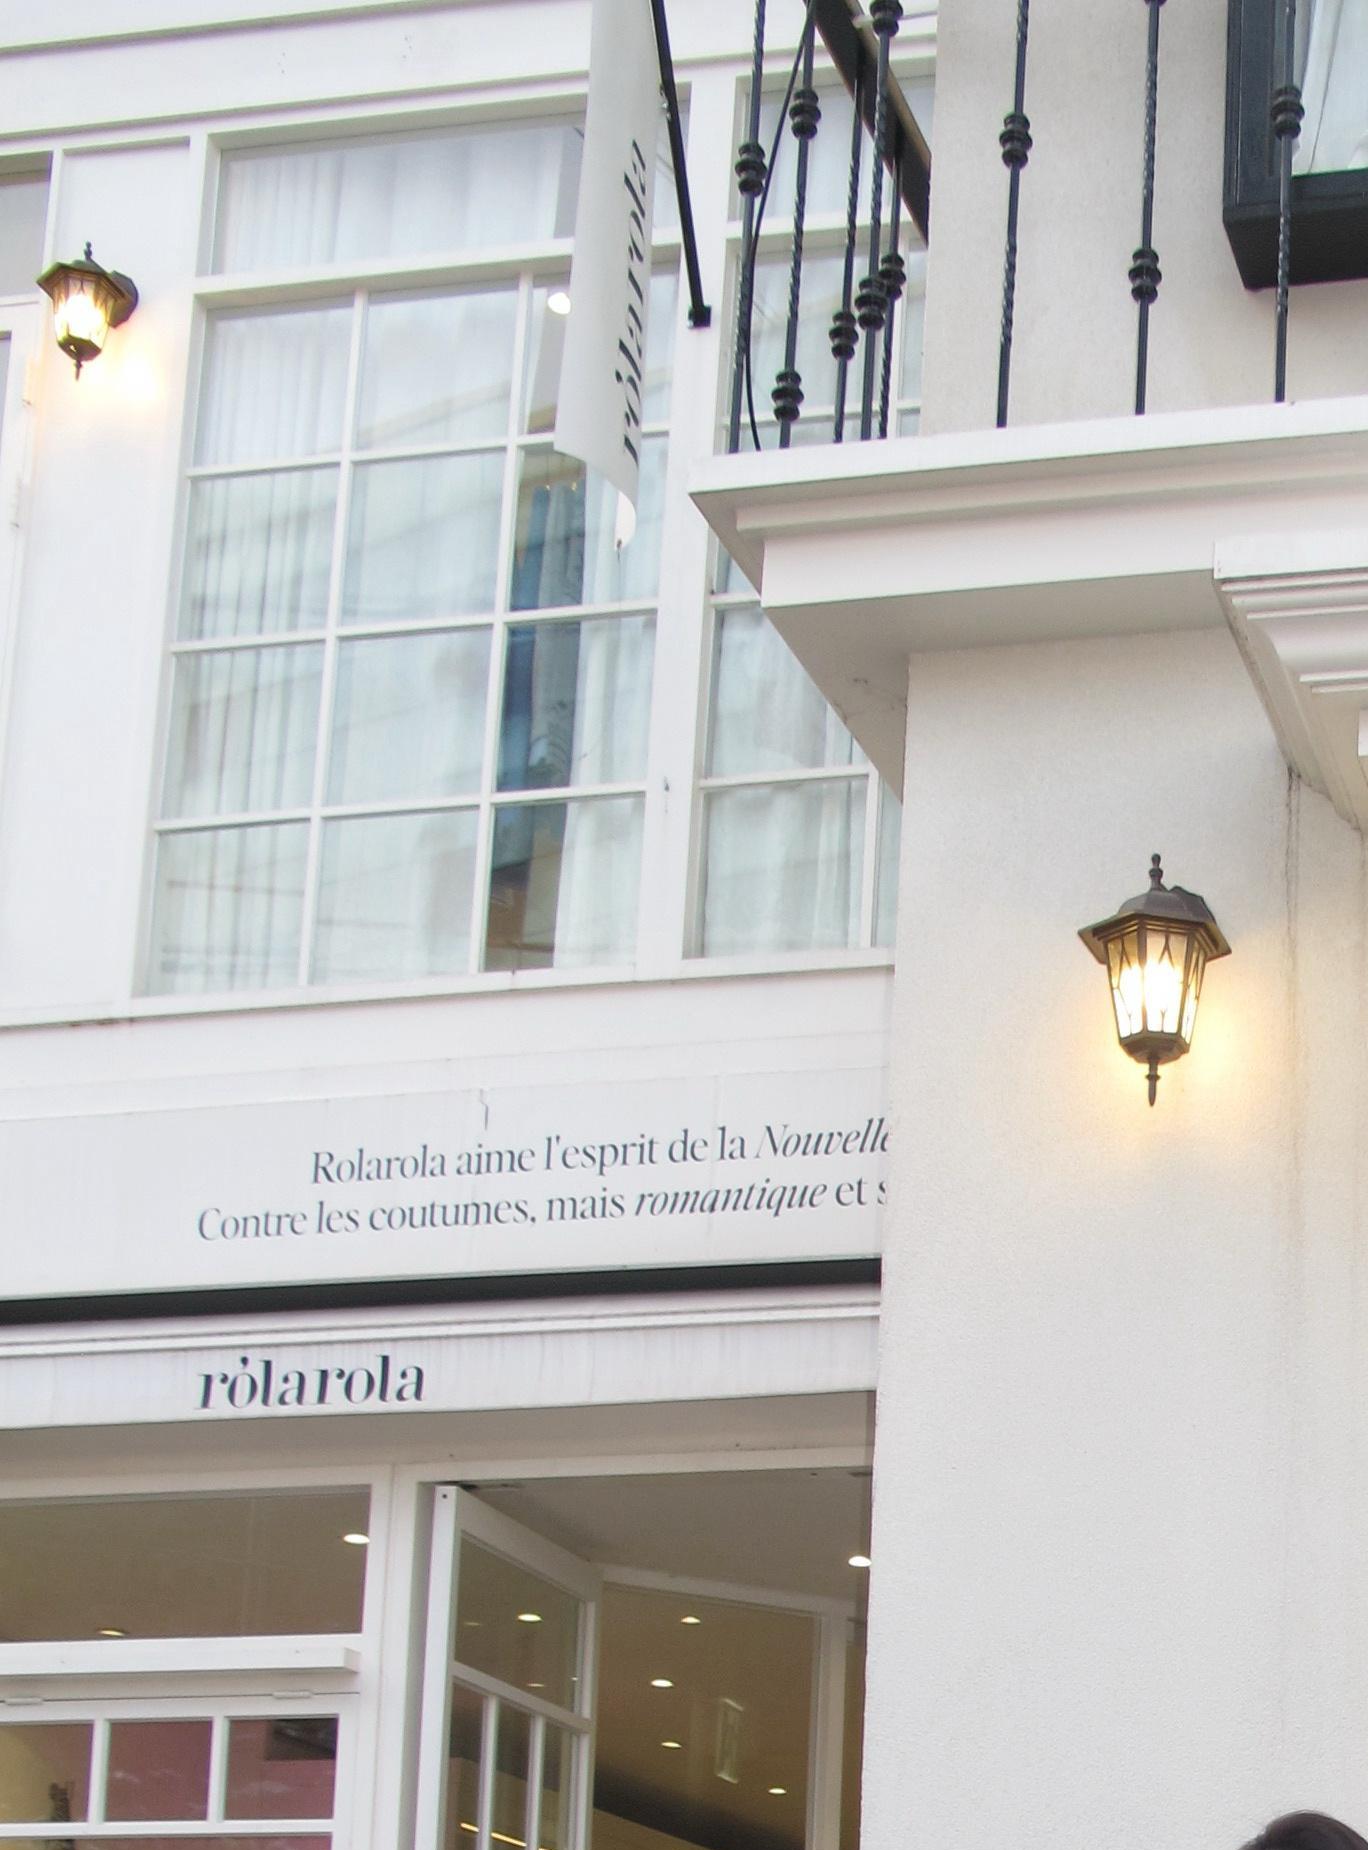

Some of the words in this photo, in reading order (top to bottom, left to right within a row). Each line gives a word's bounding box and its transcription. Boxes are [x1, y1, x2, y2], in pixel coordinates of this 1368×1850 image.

[312, 1144, 446, 1184] Rolarola
[455, 1143, 536, 1176] aime
[545, 1134, 662, 1177] l'esprit
[668, 1128, 708, 1163] de
[717, 1125, 746, 1160] la
[198, 1207, 308, 1241] Contre
[316, 1200, 360, 1234] les
[368, 1198, 537, 1233] coutumes,
[546, 1187, 626, 1222] mais
[635, 1177, 828, 1218] romantique
[835, 1176, 868, 1206] et
